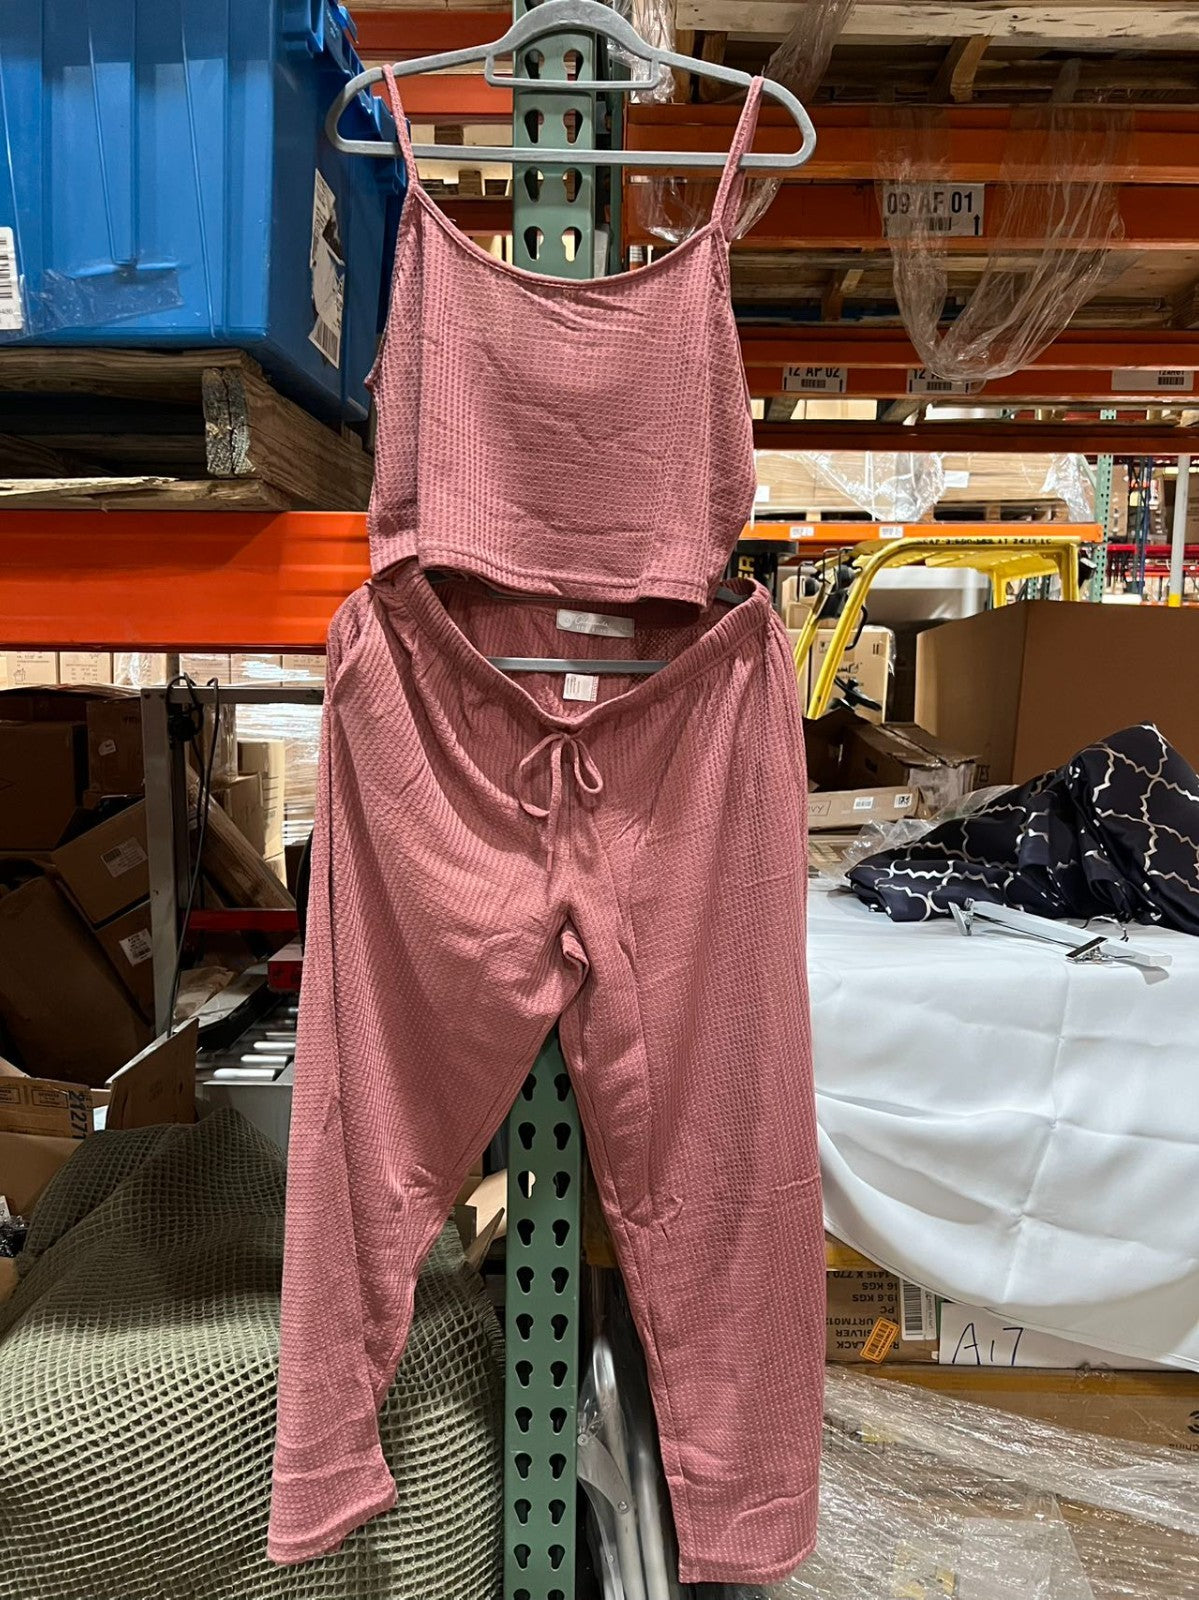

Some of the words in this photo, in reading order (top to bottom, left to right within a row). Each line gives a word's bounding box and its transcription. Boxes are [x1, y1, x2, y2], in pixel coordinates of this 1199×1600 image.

[887, 192, 911, 215] 09
[951, 190, 973, 214] 01
[913, 368, 926, 380] 12
[861, 1282, 884, 1291] KGS
[851, 1293, 874, 1303] KGS
[879, 1305, 895, 1315] PC
[835, 1329, 873, 1338] SILVER
[951, 1322, 1024, 1367] A17
